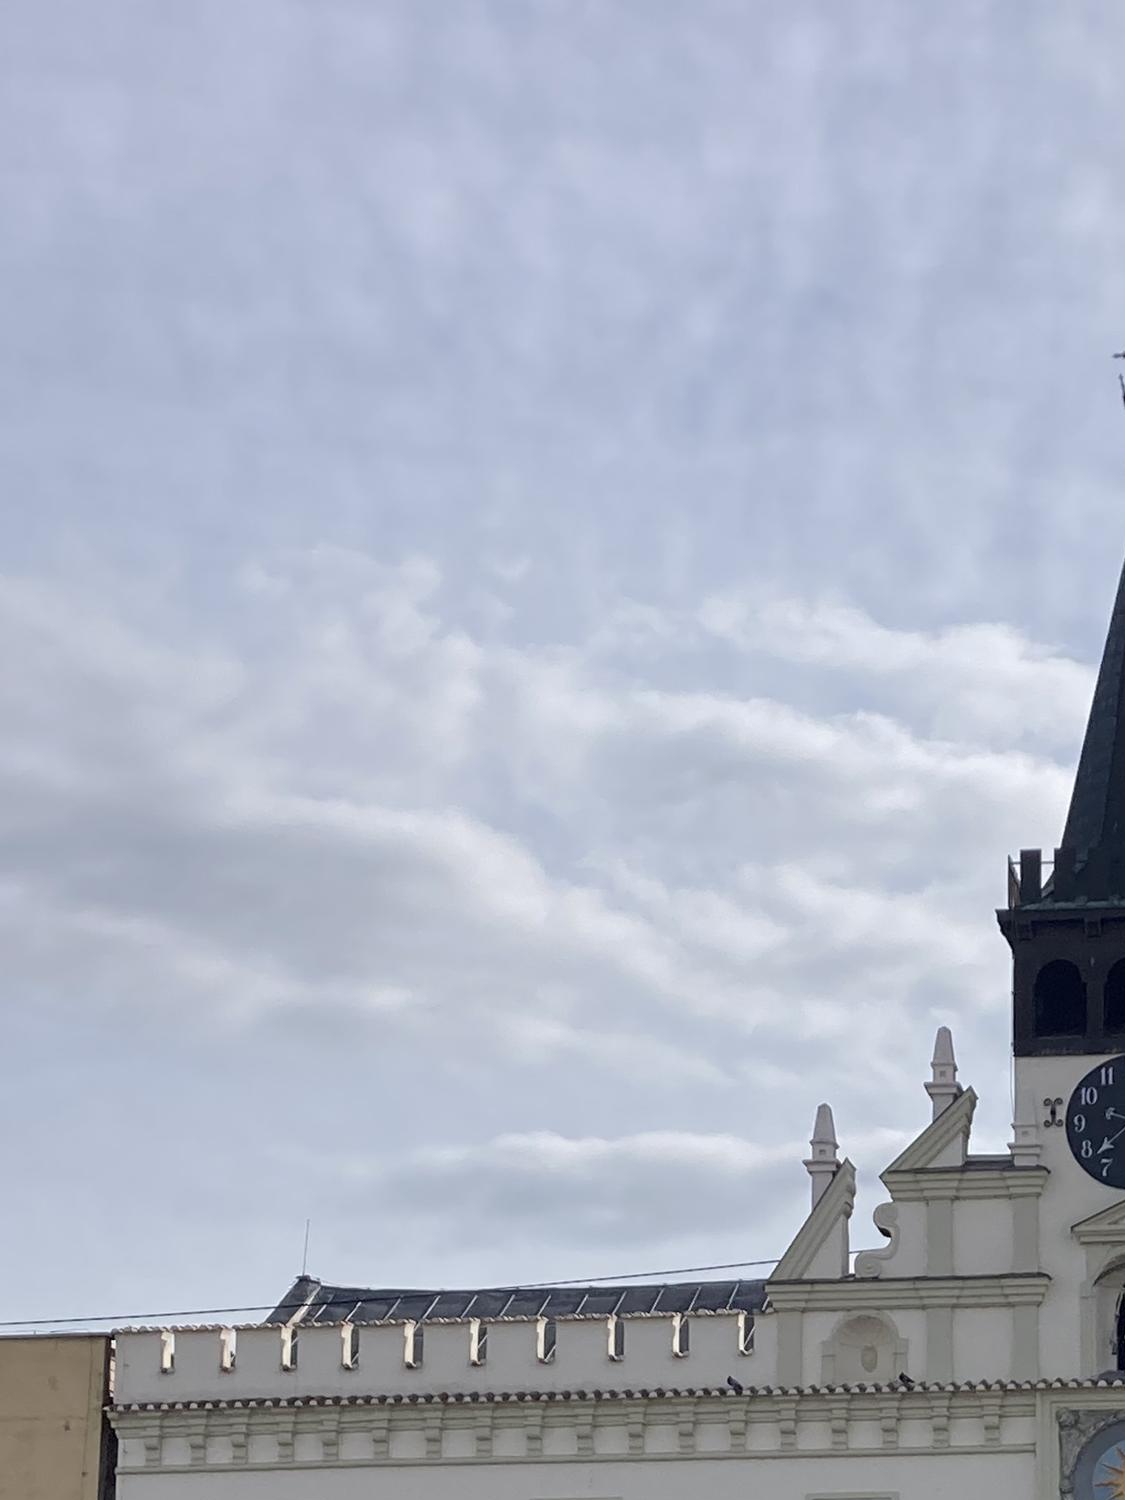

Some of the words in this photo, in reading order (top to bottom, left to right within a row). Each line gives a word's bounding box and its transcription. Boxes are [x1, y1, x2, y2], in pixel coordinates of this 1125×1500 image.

[1101, 1066, 1114, 1085] 11
[1081, 1087, 1098, 1105] 10
[1073, 1114, 1086, 1132] 9
[1081, 1140, 1093, 1158] 8
[1101, 1158, 1113, 1176] 7
